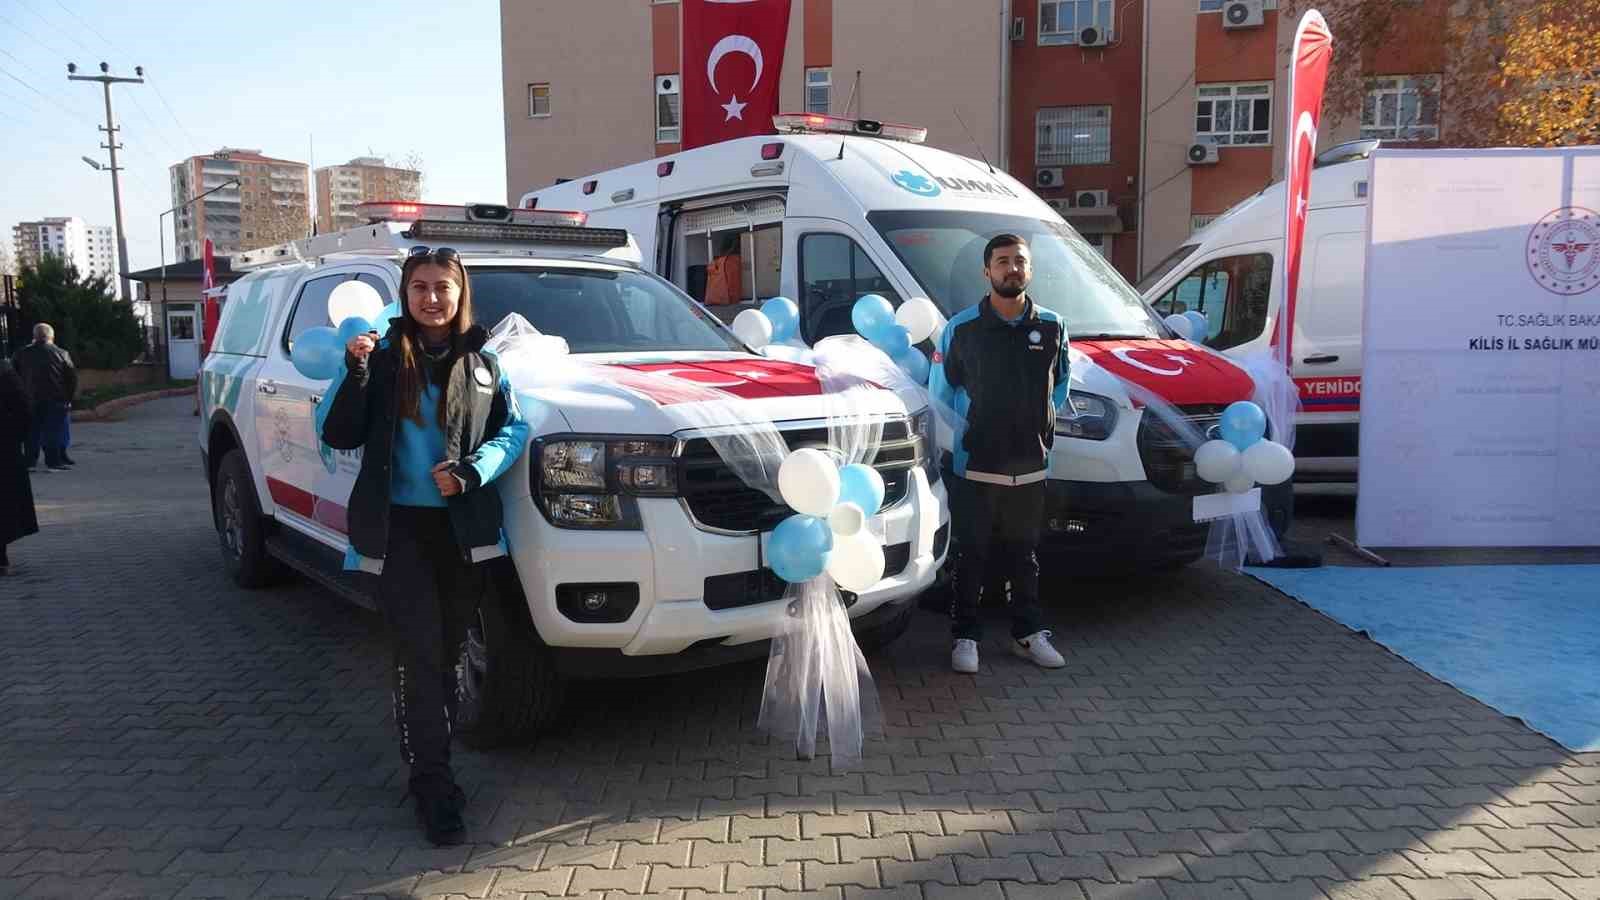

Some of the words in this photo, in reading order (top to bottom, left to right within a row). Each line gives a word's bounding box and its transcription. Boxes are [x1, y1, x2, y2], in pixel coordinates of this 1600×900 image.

[1469, 336, 1505, 350] KİLİS
[1508, 336, 1520, 350] İL
[1524, 336, 1574, 350] SAĞLIK
[1578, 336, 1600, 350] MÜ
